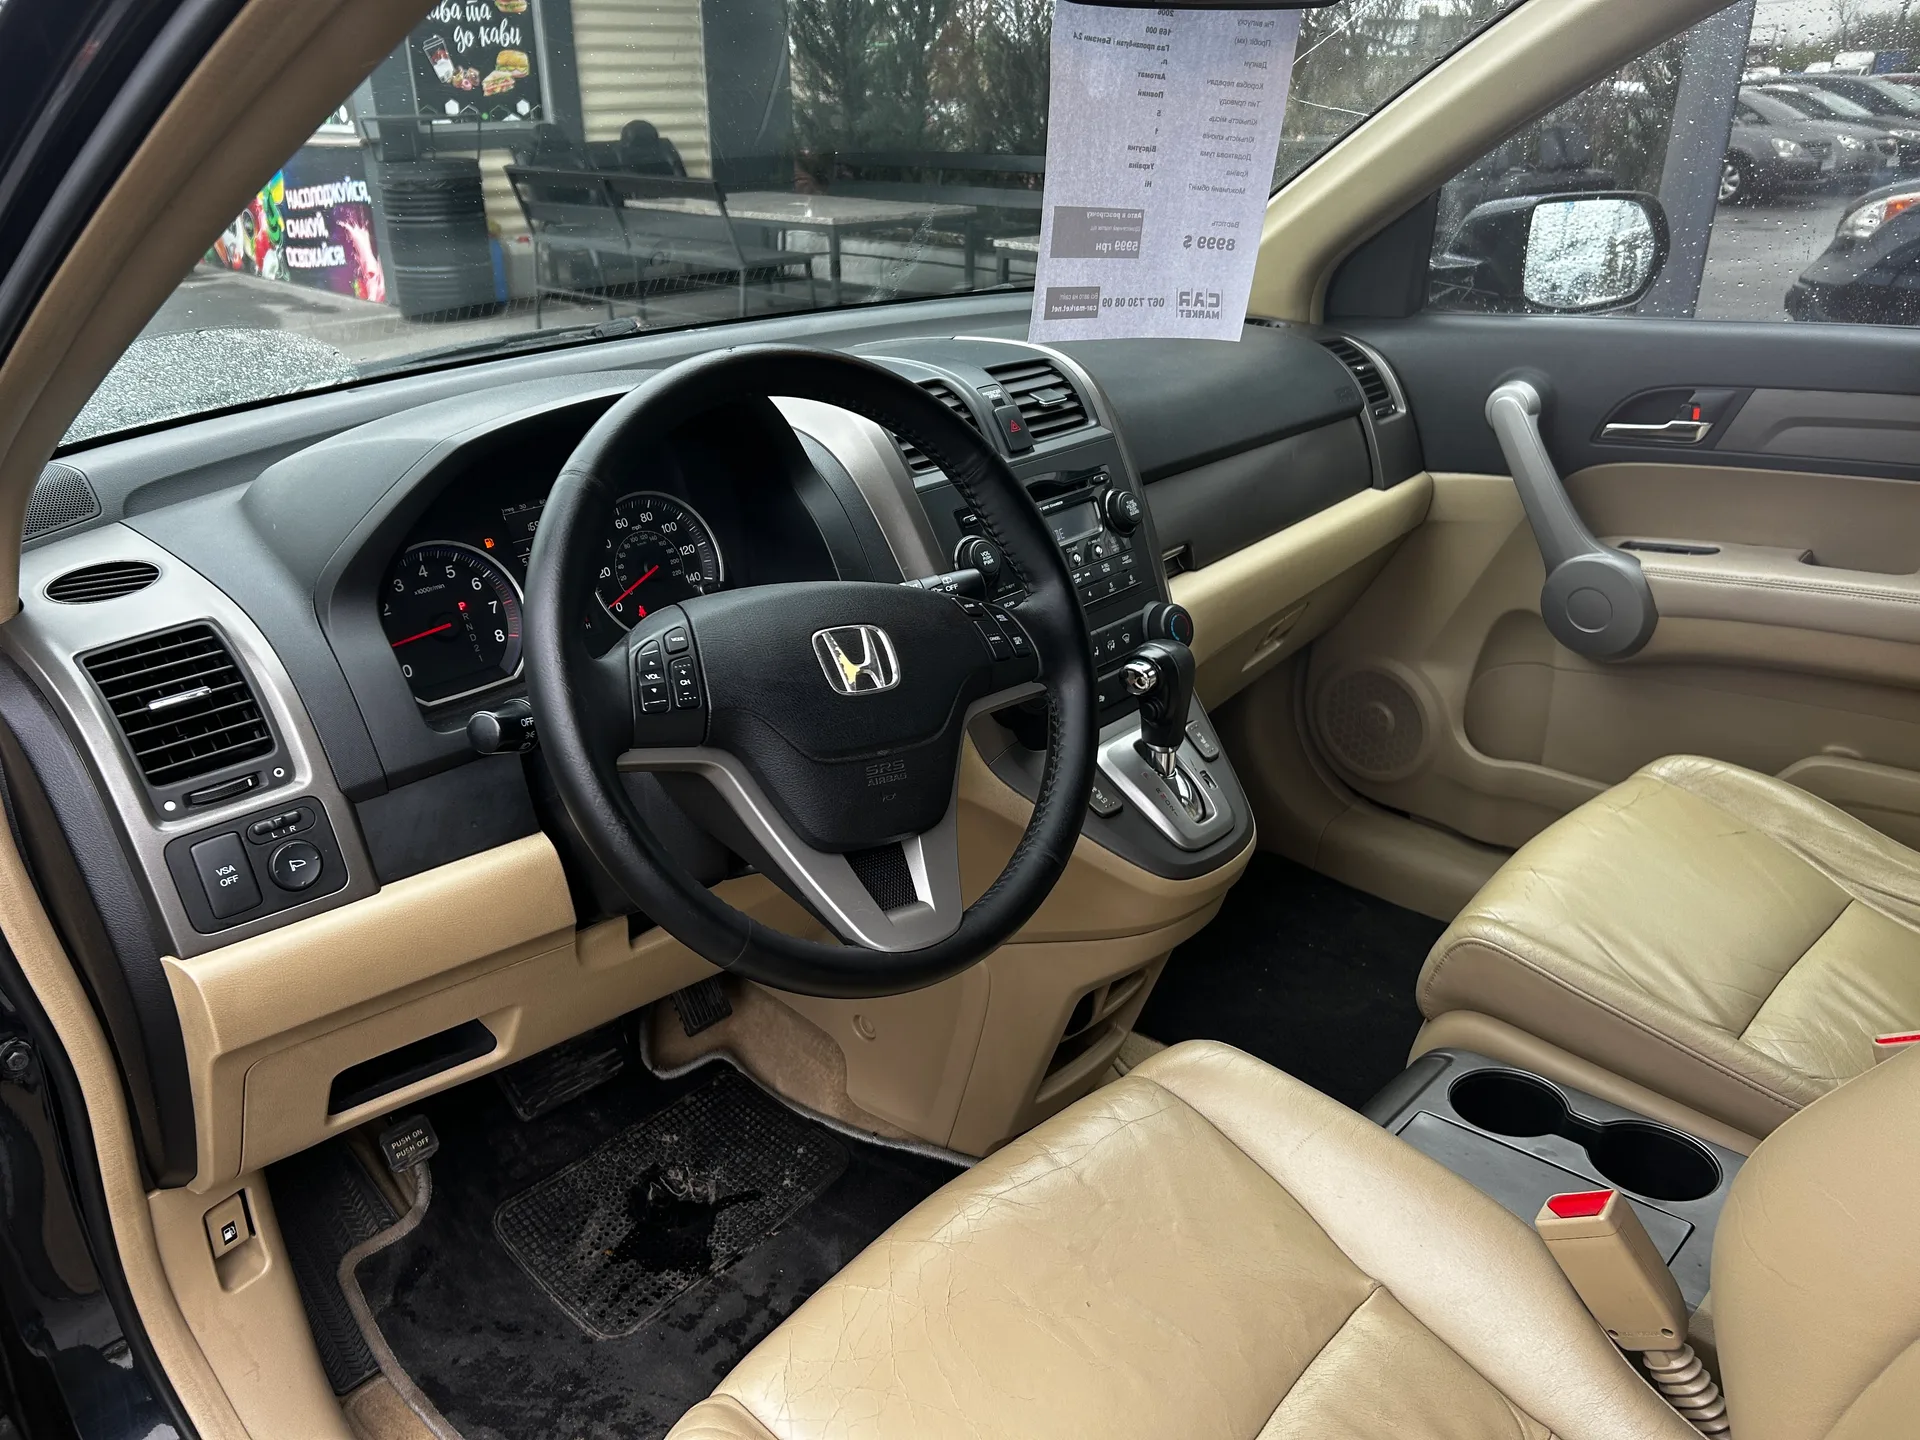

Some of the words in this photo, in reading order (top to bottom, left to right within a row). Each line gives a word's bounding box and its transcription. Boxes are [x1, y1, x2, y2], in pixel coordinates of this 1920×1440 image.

[426, 0, 462, 23] ава
[453, 25, 475, 53] до
[478, 18, 522, 47] кави
[615, 518, 628, 529] 60
[640, 511, 653, 522] 80
[661, 522, 677, 533] 100
[679, 544, 695, 556] 120
[418, 564, 428, 578] 4
[445, 565, 456, 579] 5
[600, 566, 611, 579] 20
[685, 571, 701, 583] 140
[393, 578, 405, 593] 3
[471, 577, 482, 591] 6
[944, 583, 959, 592] OFF
[457, 601, 467, 611] P
[487, 600, 498, 614] 7
[615, 602, 624, 612] 0
[466, 623, 474, 632] N
[585, 622, 592, 630] H
[469, 633, 478, 642] D
[494, 629, 505, 643] 8
[402, 664, 413, 678] 0
[520, 716, 535, 728] OFF
[865, 759, 905, 776] SRS
[867, 772, 907, 787] AIRBAG
[271, 831, 278, 839] L
[289, 825, 297, 833] R
[215, 864, 236, 877] VSA
[219, 874, 239, 888] OFF
[391, 1135, 411, 1150] PUSH
[412, 1128, 423, 1139] ON
[395, 1145, 416, 1159] PUSH
[416, 1135, 430, 1148] OFF
